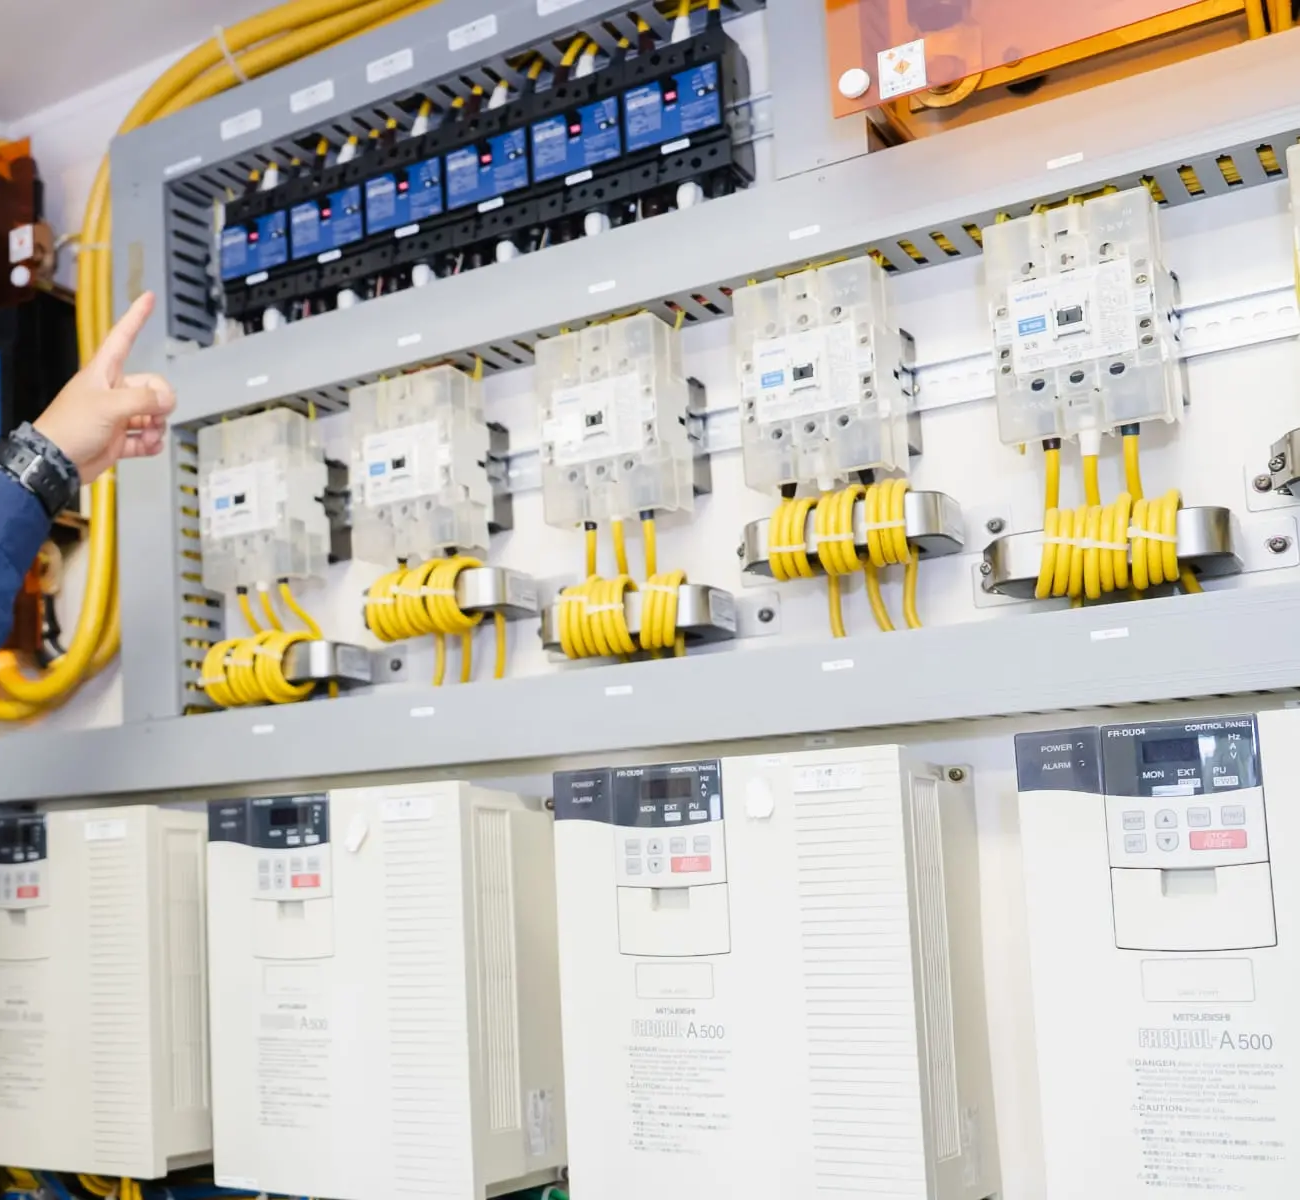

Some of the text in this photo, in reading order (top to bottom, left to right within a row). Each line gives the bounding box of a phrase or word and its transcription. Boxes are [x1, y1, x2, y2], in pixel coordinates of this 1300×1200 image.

[1185, 720, 1252, 732] CONTROL PANEL
[1107, 728, 1146, 738] FR-DU04
[1228, 733, 1241, 741] Hz
[1040, 743, 1073, 753] POWER
[1042, 761, 1071, 771] ALARM
[1142, 766, 1227, 779] MON EXT PU
[688, 802, 700, 810] PU
[1173, 1013, 1231, 1022] MITSUBISHI
